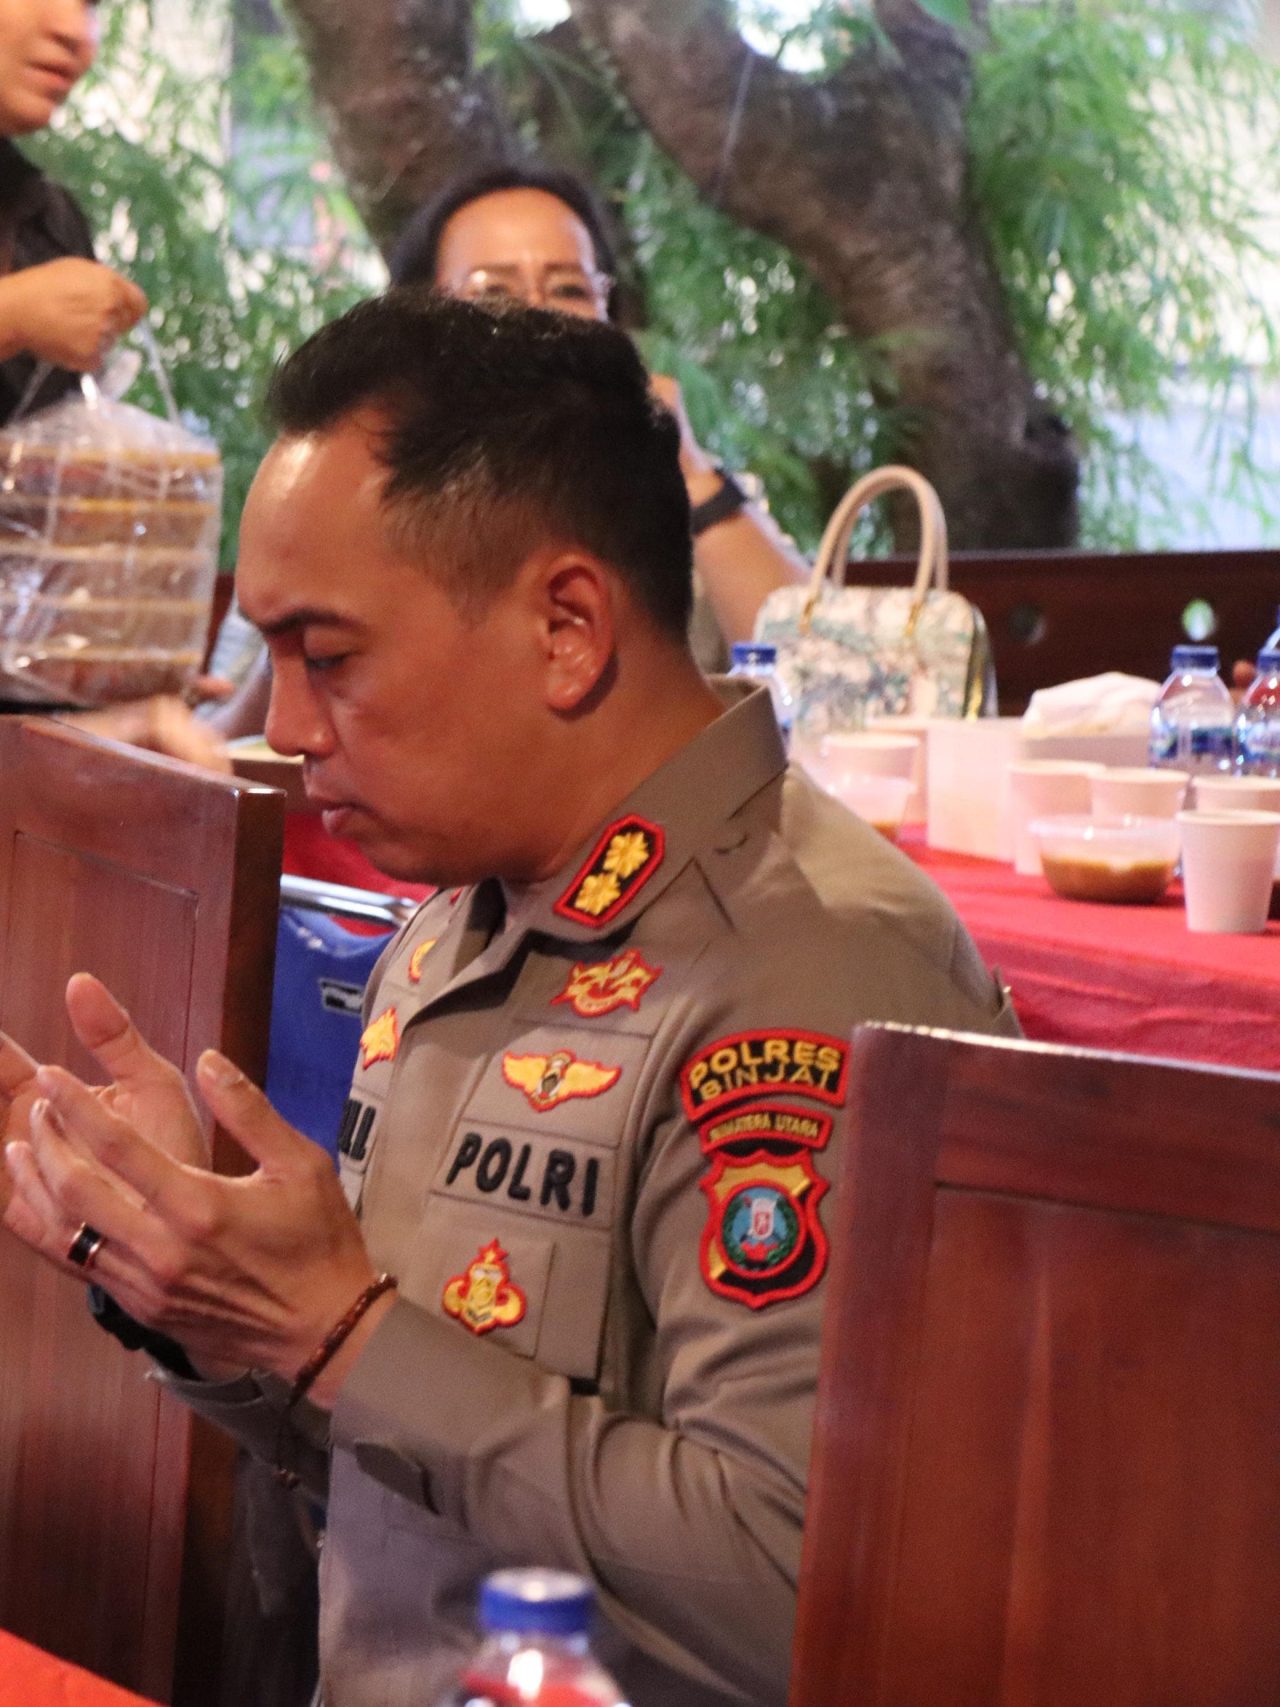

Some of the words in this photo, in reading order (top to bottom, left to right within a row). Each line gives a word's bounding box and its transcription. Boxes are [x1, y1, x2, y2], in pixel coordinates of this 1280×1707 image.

[689, 1039, 841, 1089] POLRES
[699, 1063, 831, 1101] BINJAI
[774, 1113, 818, 1138] UTARA
[445, 1131, 599, 1217] POLRI
